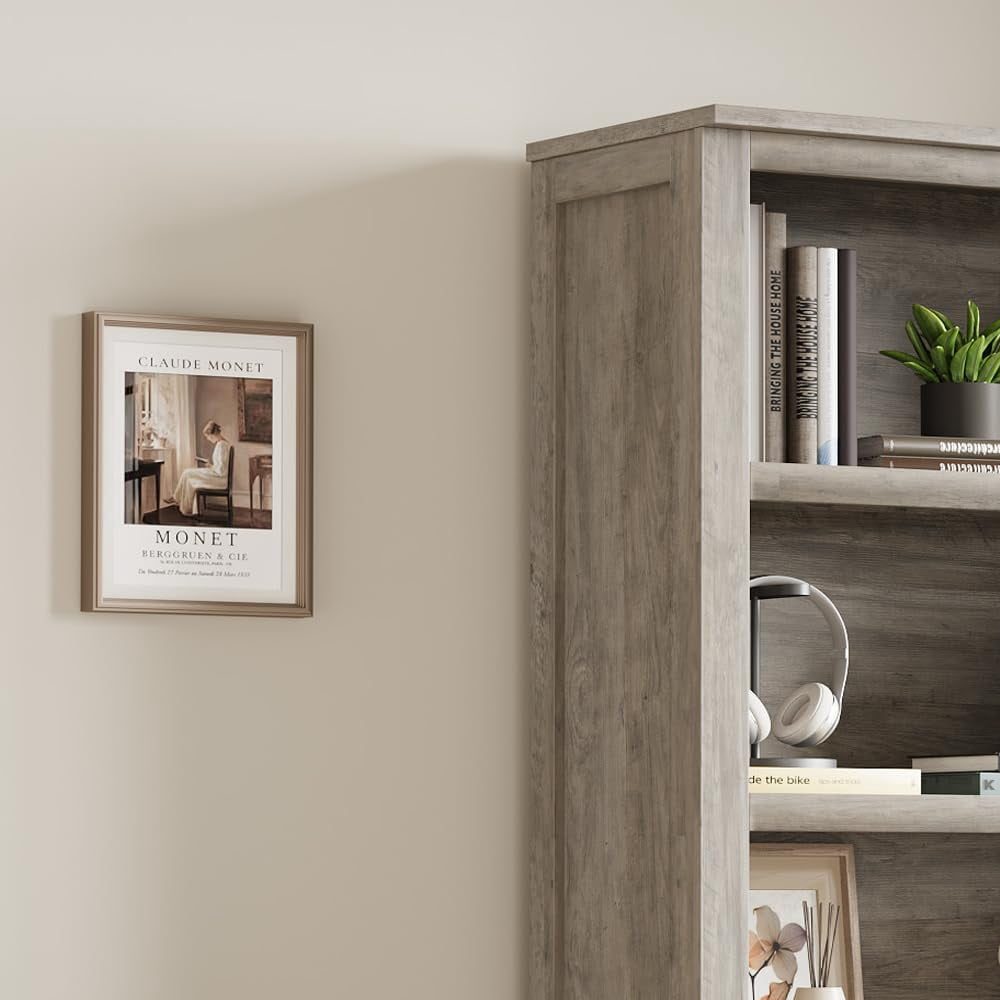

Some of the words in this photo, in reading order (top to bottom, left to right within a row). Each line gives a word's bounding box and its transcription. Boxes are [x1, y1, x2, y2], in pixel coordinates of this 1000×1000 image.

[771, 270, 781, 298] HOME
[771, 302, 781, 336] HOUSE
[796, 296, 818, 321] HOME
[771, 339, 781, 359] THE
[796, 324, 818, 353] HOUSE
[138, 356, 201, 370] CLAUDE
[208, 360, 264, 373] MONET
[796, 357, 818, 373] THE
[771, 362, 781, 412] BRINGING
[796, 376, 818, 419] BRINGING
[155, 530, 238, 546] MONET
[142, 550, 212, 560] BERGGRUEN
[229, 553, 249, 561] CIE
[765, 775, 783, 784] the
[787, 775, 810, 784] bike
